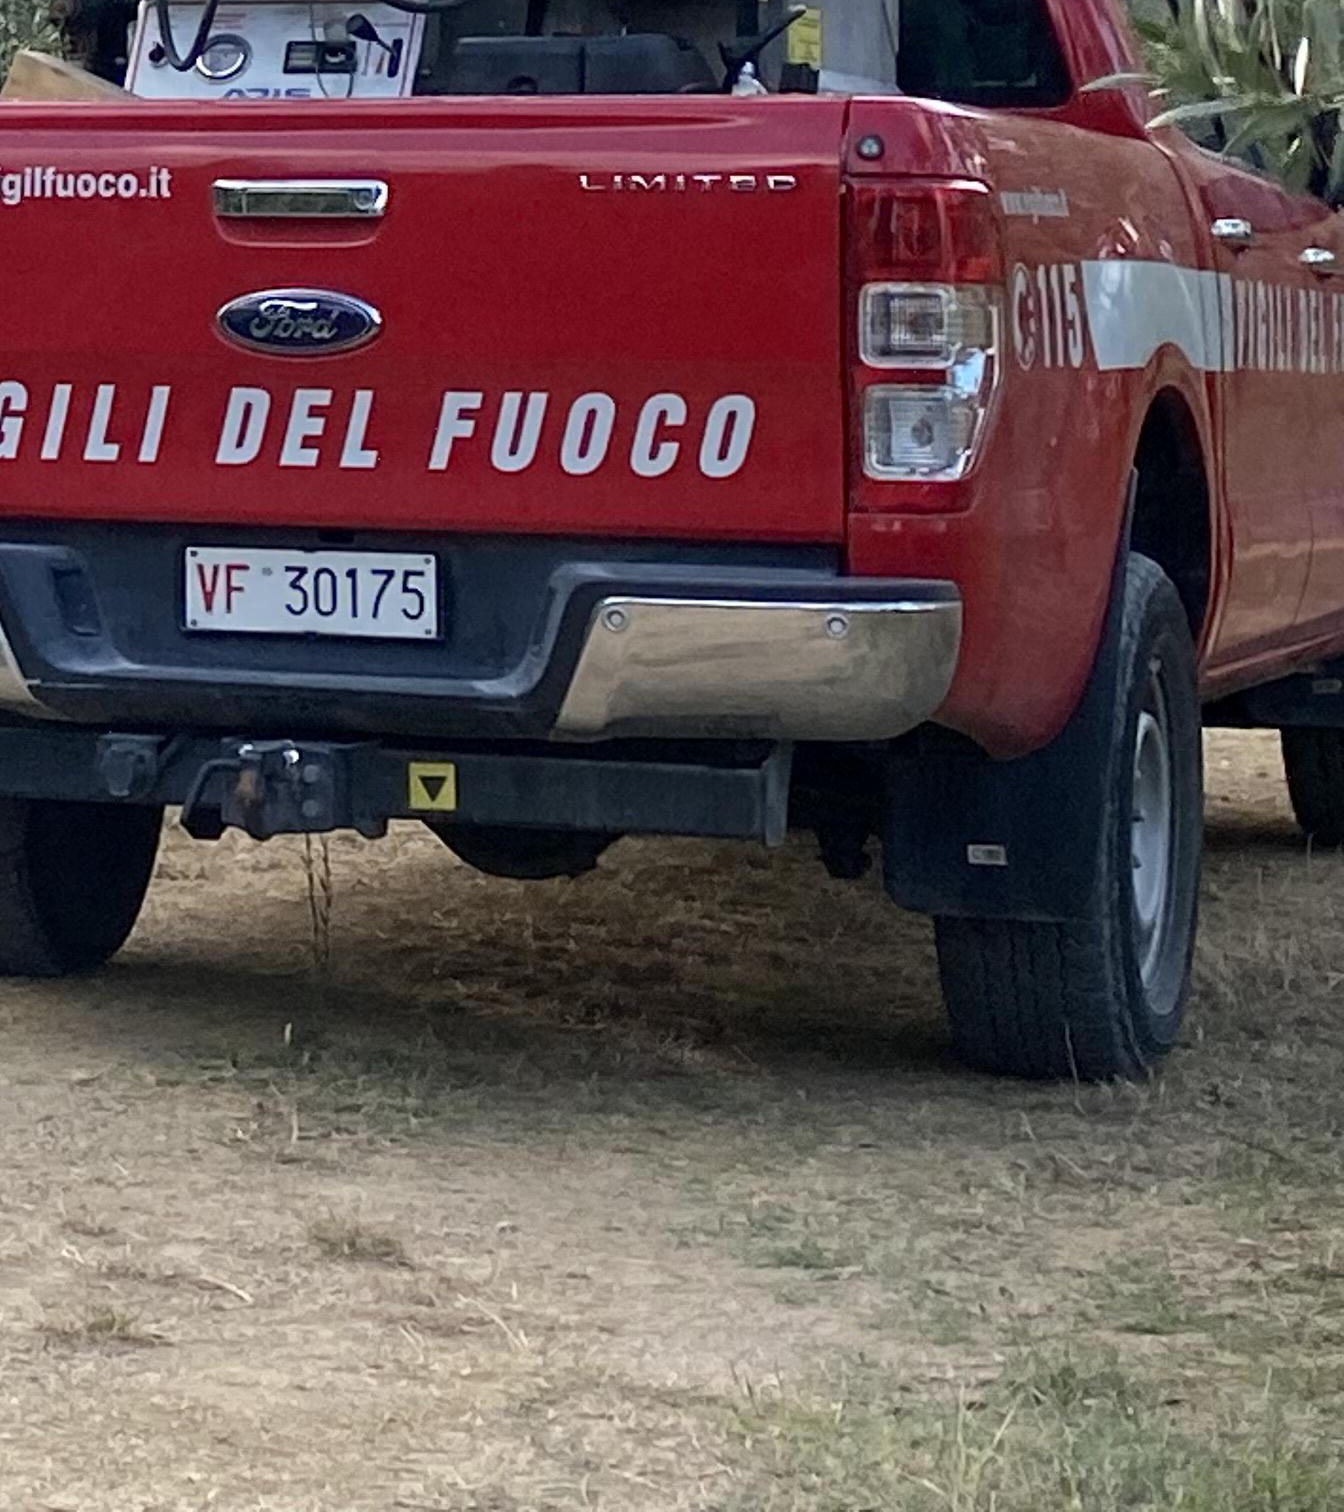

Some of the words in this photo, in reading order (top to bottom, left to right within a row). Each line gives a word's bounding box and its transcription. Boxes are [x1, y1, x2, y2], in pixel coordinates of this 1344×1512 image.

[578, 174, 798, 192] LIMITED
[248, 299, 339, 339] Ford
[214, 386, 379, 469] DEL
[427, 390, 757, 478] FUOCO
[196, 563, 251, 615] VF
[284, 565, 426, 620] 30175
